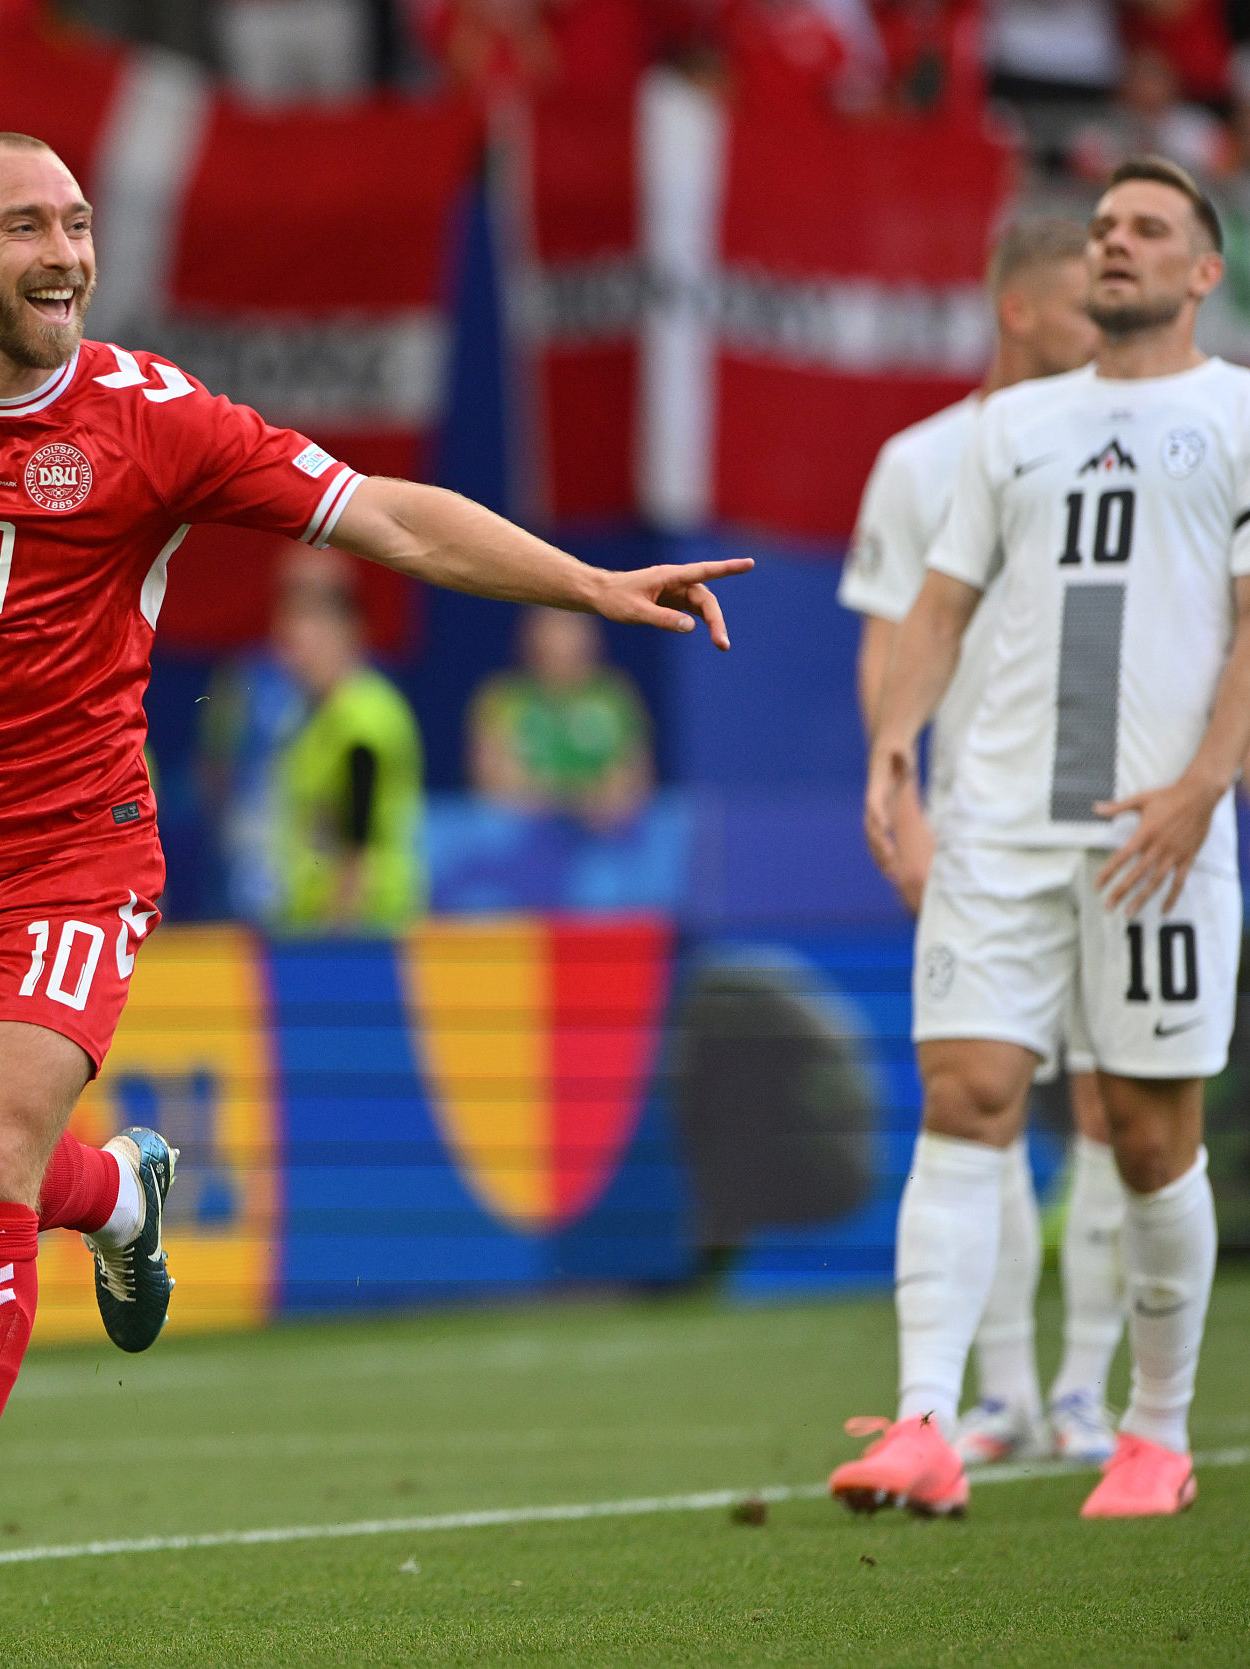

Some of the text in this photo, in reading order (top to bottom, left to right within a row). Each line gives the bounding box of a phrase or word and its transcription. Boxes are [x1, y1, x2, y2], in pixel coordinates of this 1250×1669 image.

[27, 463, 44, 502] DANSK
[75, 464, 90, 500] UNION
[38, 465, 79, 486] DBU
[46, 500, 73, 509] 1889
[1058, 489, 1135, 565] 10
[19, 919, 105, 1011] 10
[1125, 922, 1199, 1003] 10
